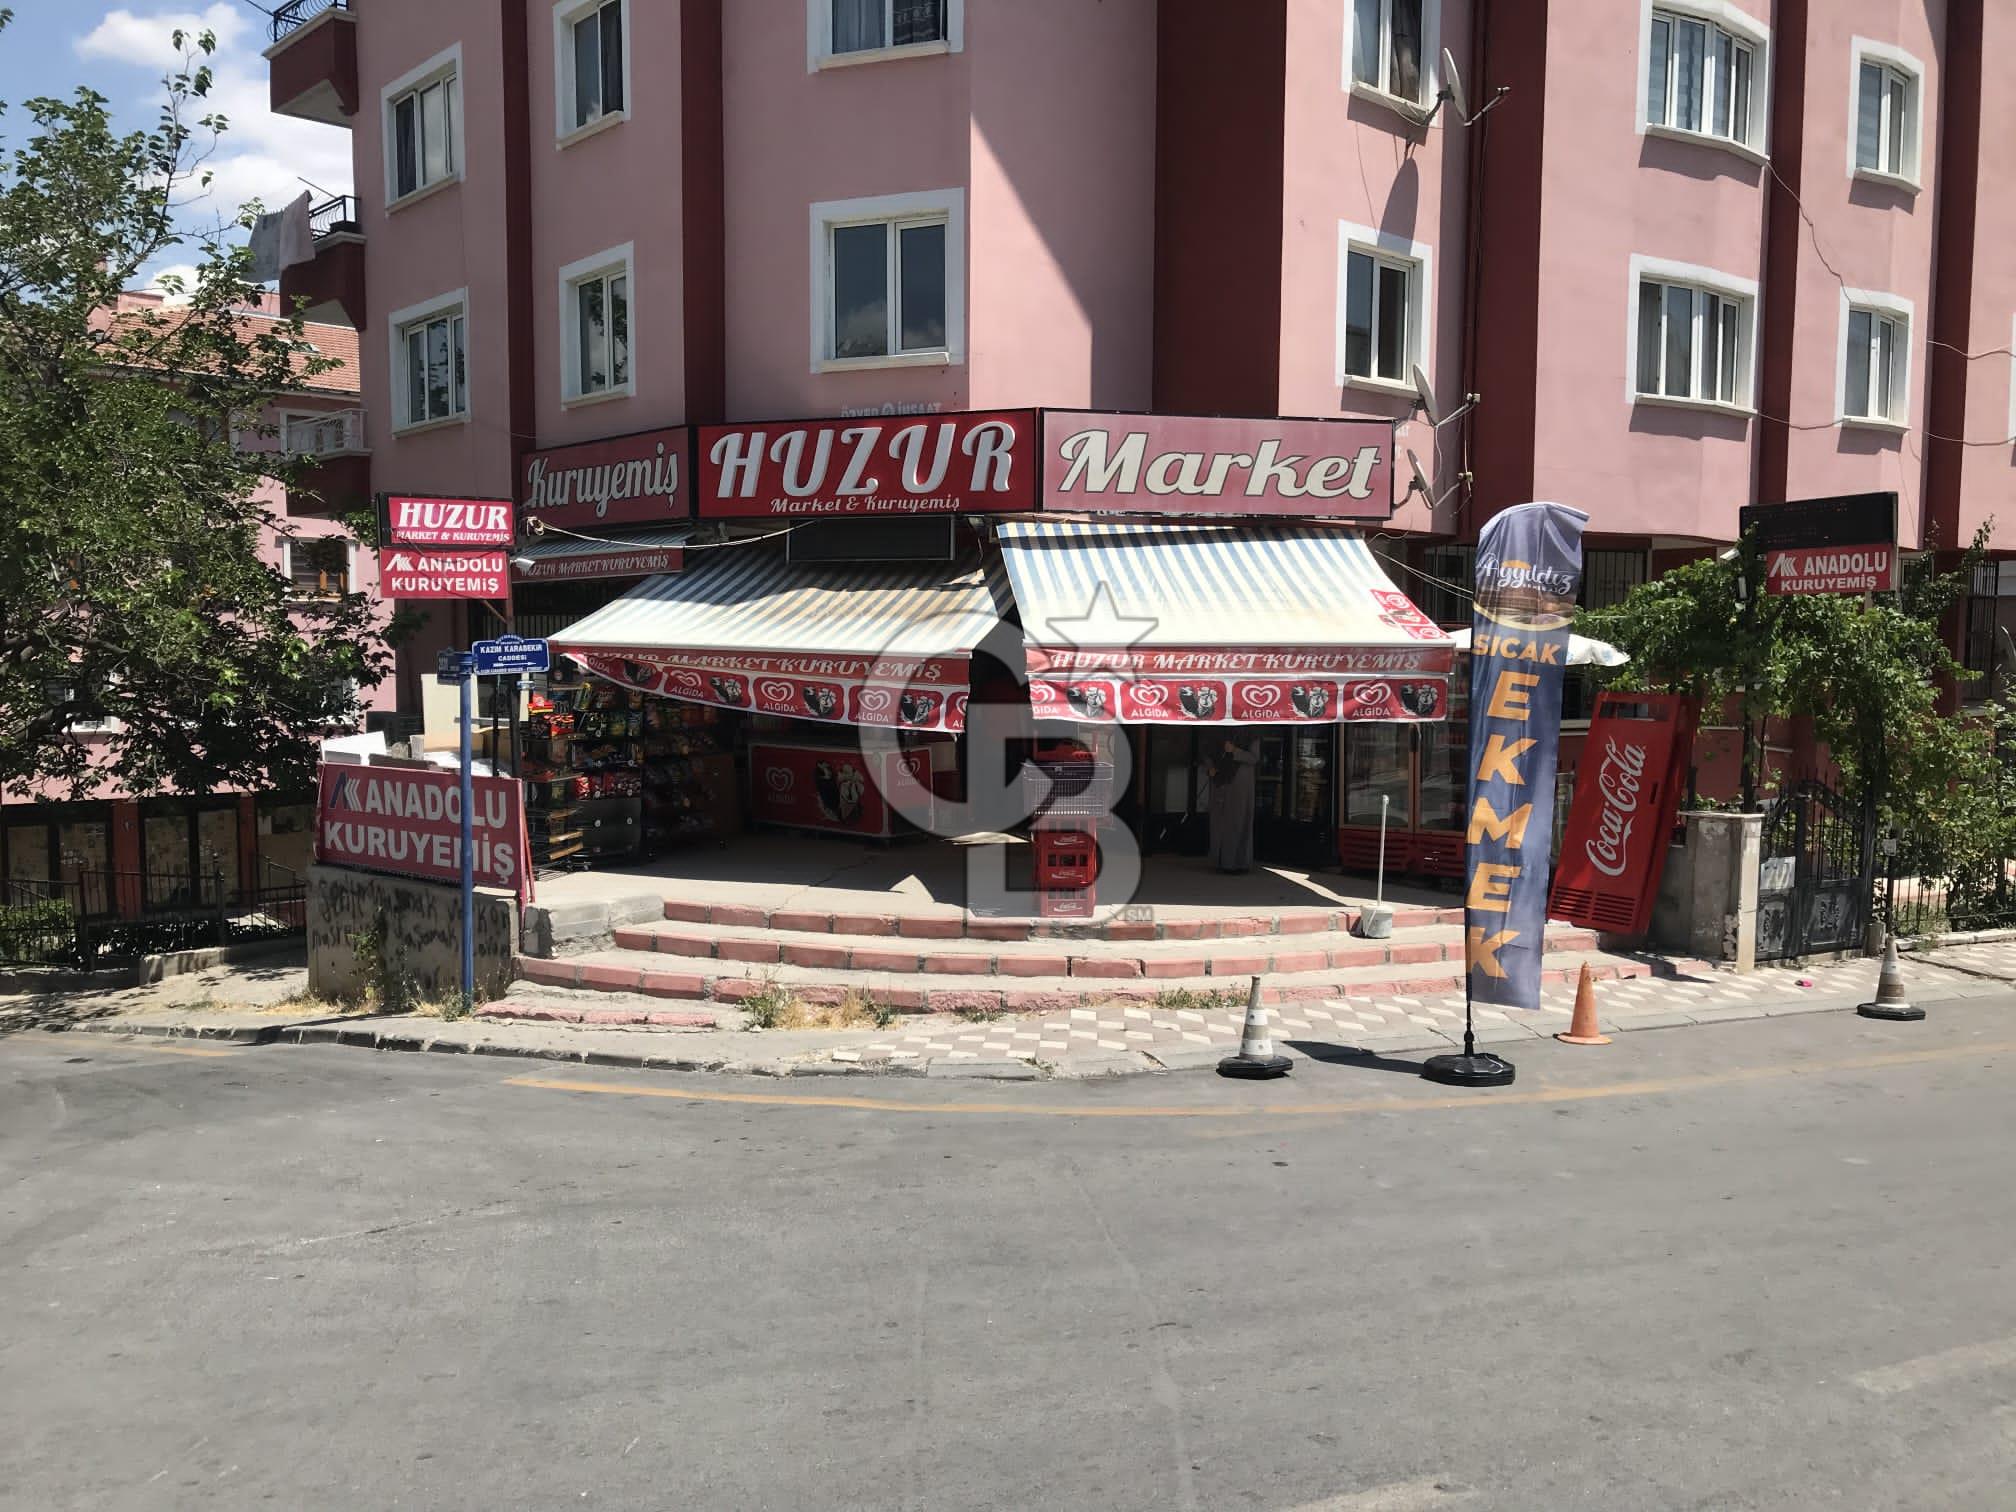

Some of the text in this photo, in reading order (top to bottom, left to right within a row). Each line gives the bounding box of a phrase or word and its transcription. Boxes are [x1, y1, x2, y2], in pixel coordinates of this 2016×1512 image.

[710, 420, 1016, 499] HUZUR
[1057, 429, 1382, 499] Market
[527, 443, 679, 518] Kuruyemiş
[398, 502, 508, 530] HUZUR
[770, 493, 961, 513] Market & Kuruyemiş
[397, 530, 438, 540] MARKET
[441, 532, 450, 540] &
[417, 557, 503, 572] ANADOLU
[1803, 552, 1887, 576] ANADOLU
[391, 577, 499, 594] KURUYEMİŞ
[1781, 575, 1877, 592] KURUYEMİŞ
[1050, 652, 1144, 669] HUZUR
[1153, 652, 1264, 669] MARKET
[1473, 632, 1562, 665] SICAK
[775, 657, 942, 681] KURUYEMİŞ
[365, 779, 506, 829] ANADOLU
[1466, 671, 1541, 979] EKMEK
[324, 821, 515, 885] KURUYEMİŞ
